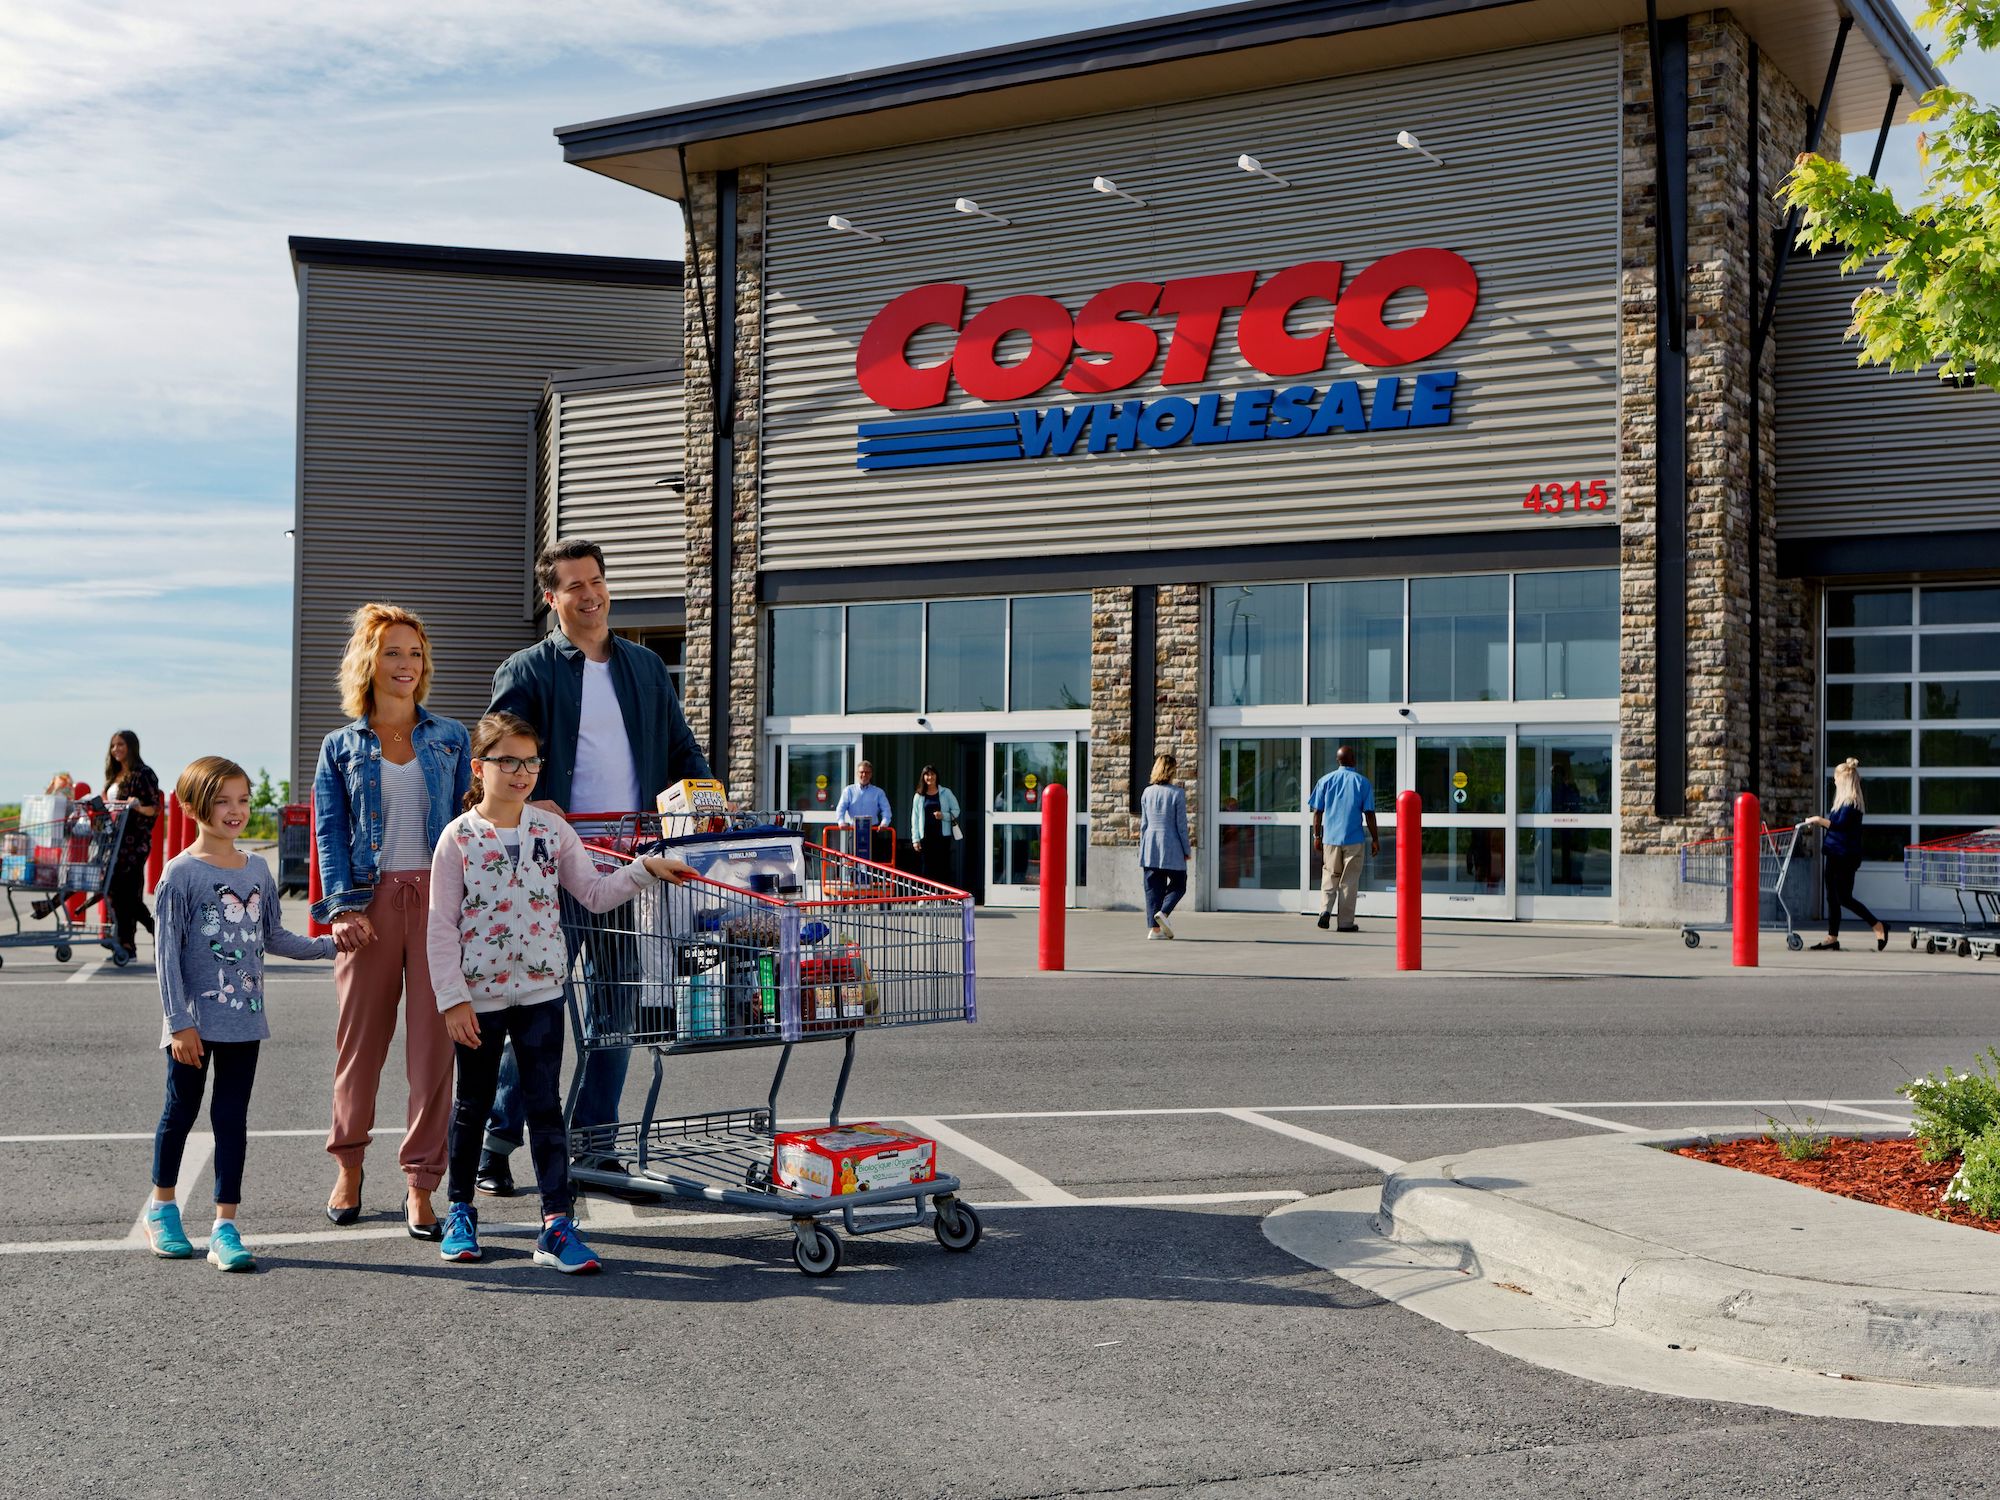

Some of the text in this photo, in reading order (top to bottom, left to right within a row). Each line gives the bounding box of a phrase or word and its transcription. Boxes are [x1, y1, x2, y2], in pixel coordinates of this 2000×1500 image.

[856, 247, 1479, 410] COSTCO
[1018, 371, 1457, 458] WHOLESALE
[1523, 480, 1608, 513] 4315
[692, 790, 712, 799] SOFT
[728, 851, 757, 860] KIRKLAND
[697, 957, 716, 966] Pies
[858, 1158, 919, 1173] Biologique Organic
